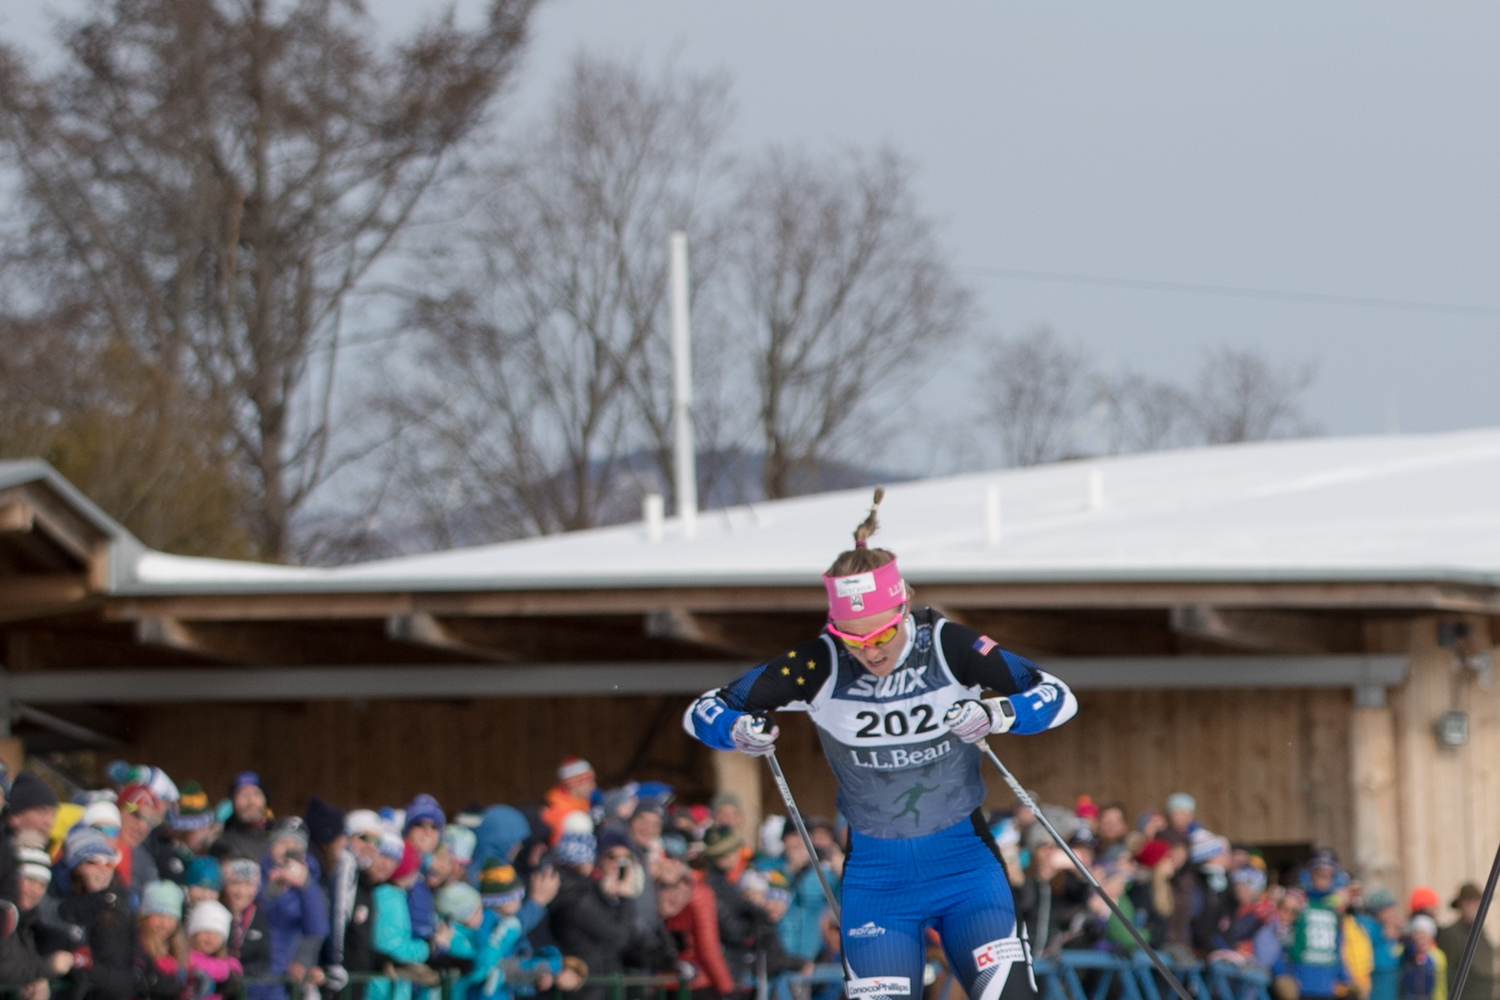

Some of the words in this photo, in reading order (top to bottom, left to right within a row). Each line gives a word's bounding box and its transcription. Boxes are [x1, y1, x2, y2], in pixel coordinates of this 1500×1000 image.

[847, 665, 928, 698] SWIX
[856, 704, 940, 738] 202
[850, 740, 952, 769] L.L.Bean
[850, 983, 908, 995] ConocoPhillips
